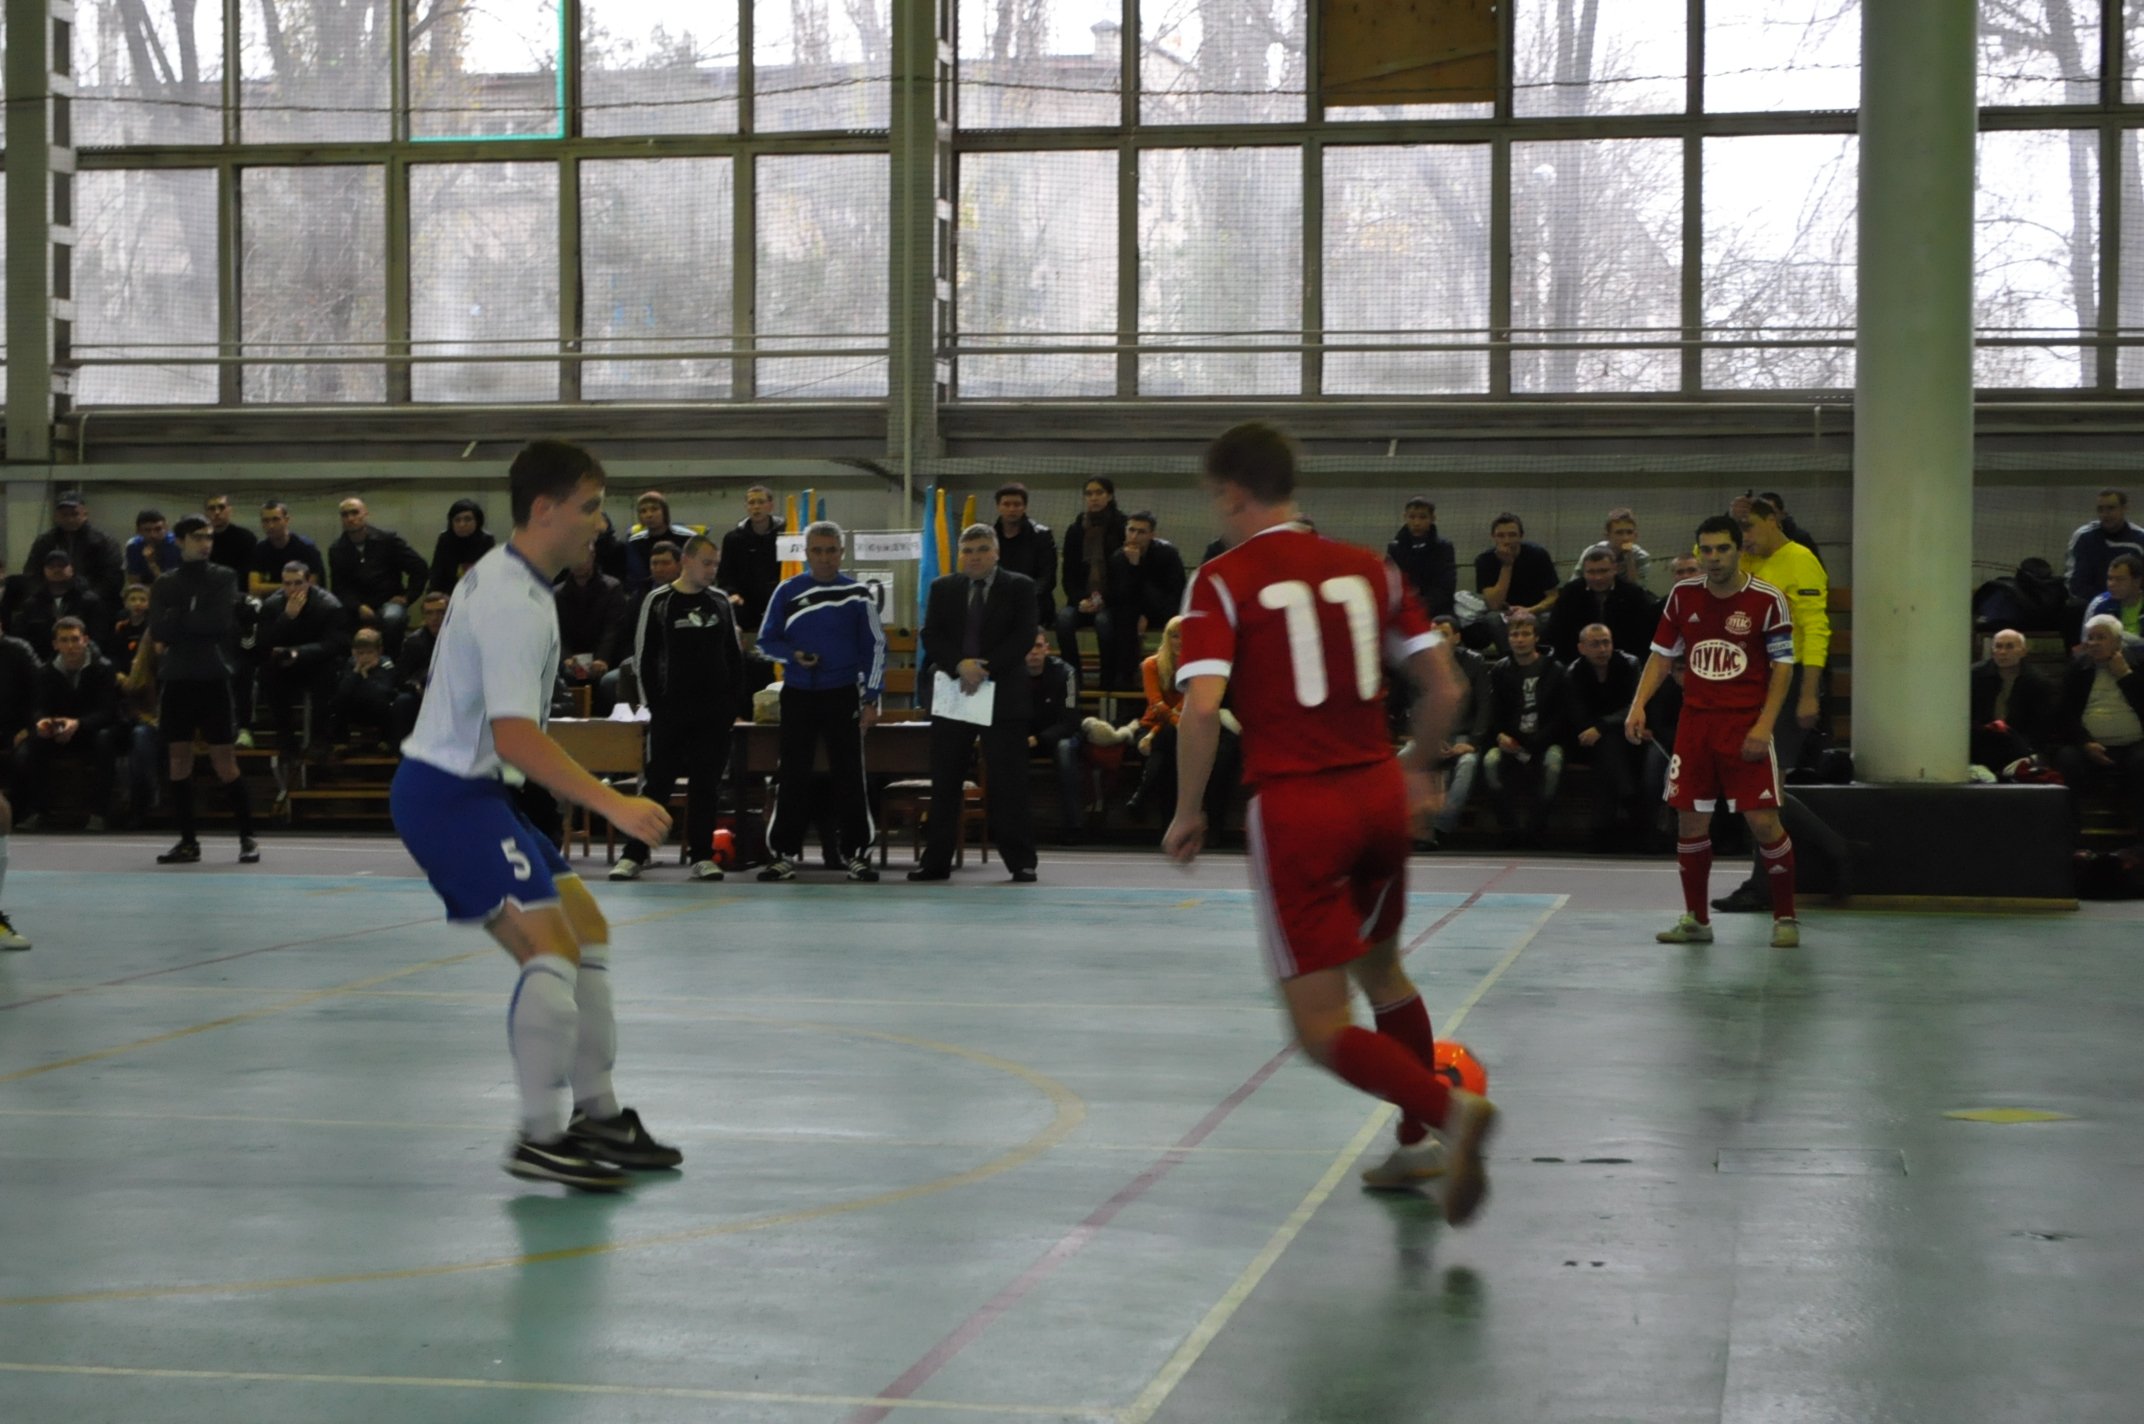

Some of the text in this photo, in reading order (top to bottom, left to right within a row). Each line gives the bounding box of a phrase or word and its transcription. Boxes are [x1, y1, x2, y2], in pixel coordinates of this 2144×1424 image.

[1258, 574, 1382, 707] 11
[1693, 646, 1742, 672] ЛУКАС
[501, 837, 531, 881] 5
